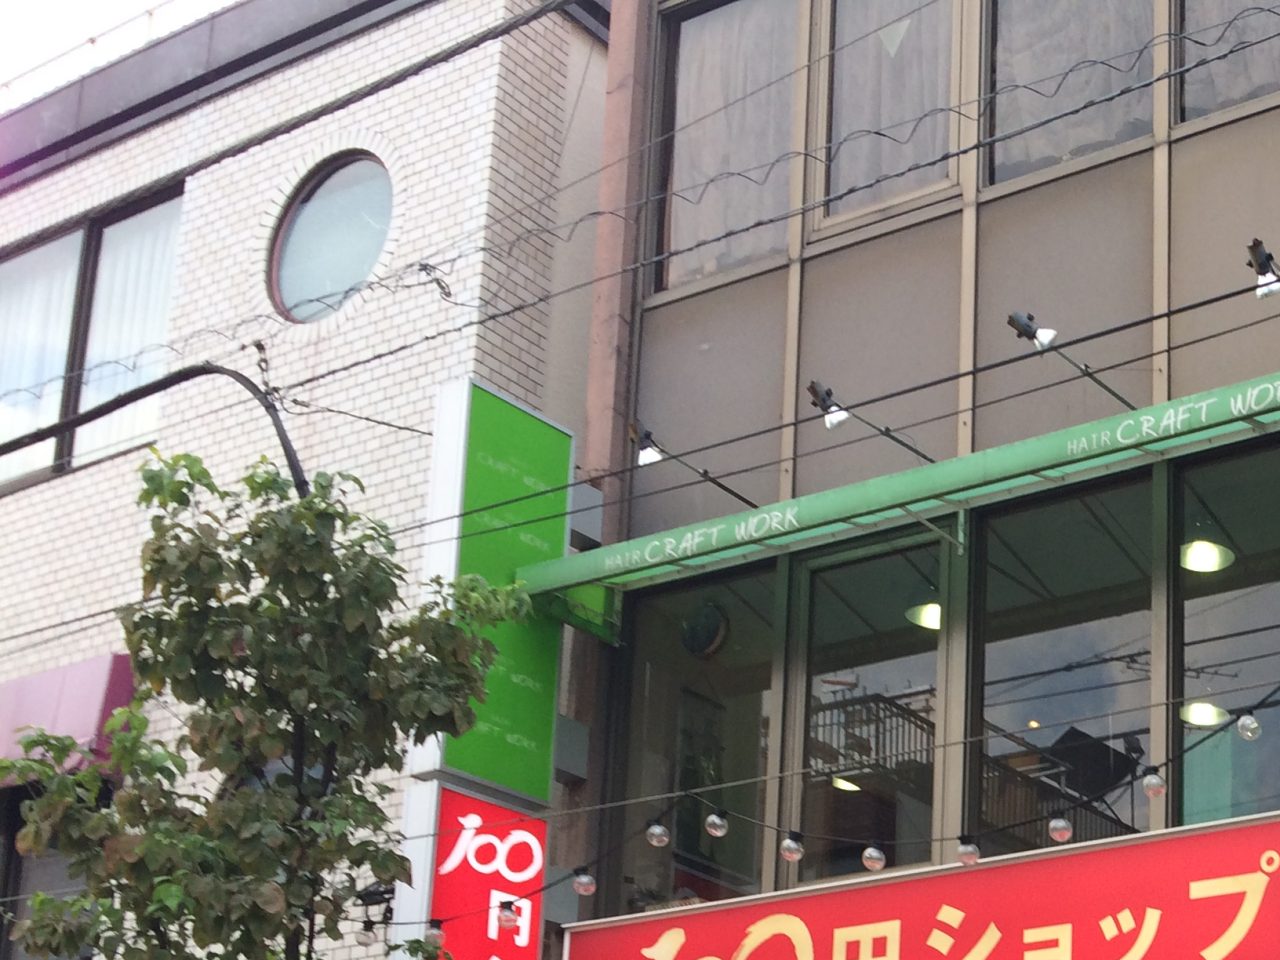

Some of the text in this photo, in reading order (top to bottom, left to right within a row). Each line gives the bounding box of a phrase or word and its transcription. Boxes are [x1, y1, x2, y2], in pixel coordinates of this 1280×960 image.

[1066, 431, 1112, 457] HAIR
[1115, 399, 1219, 446] CRAFT
[603, 504, 800, 572] HAIR CRAFT WORK
